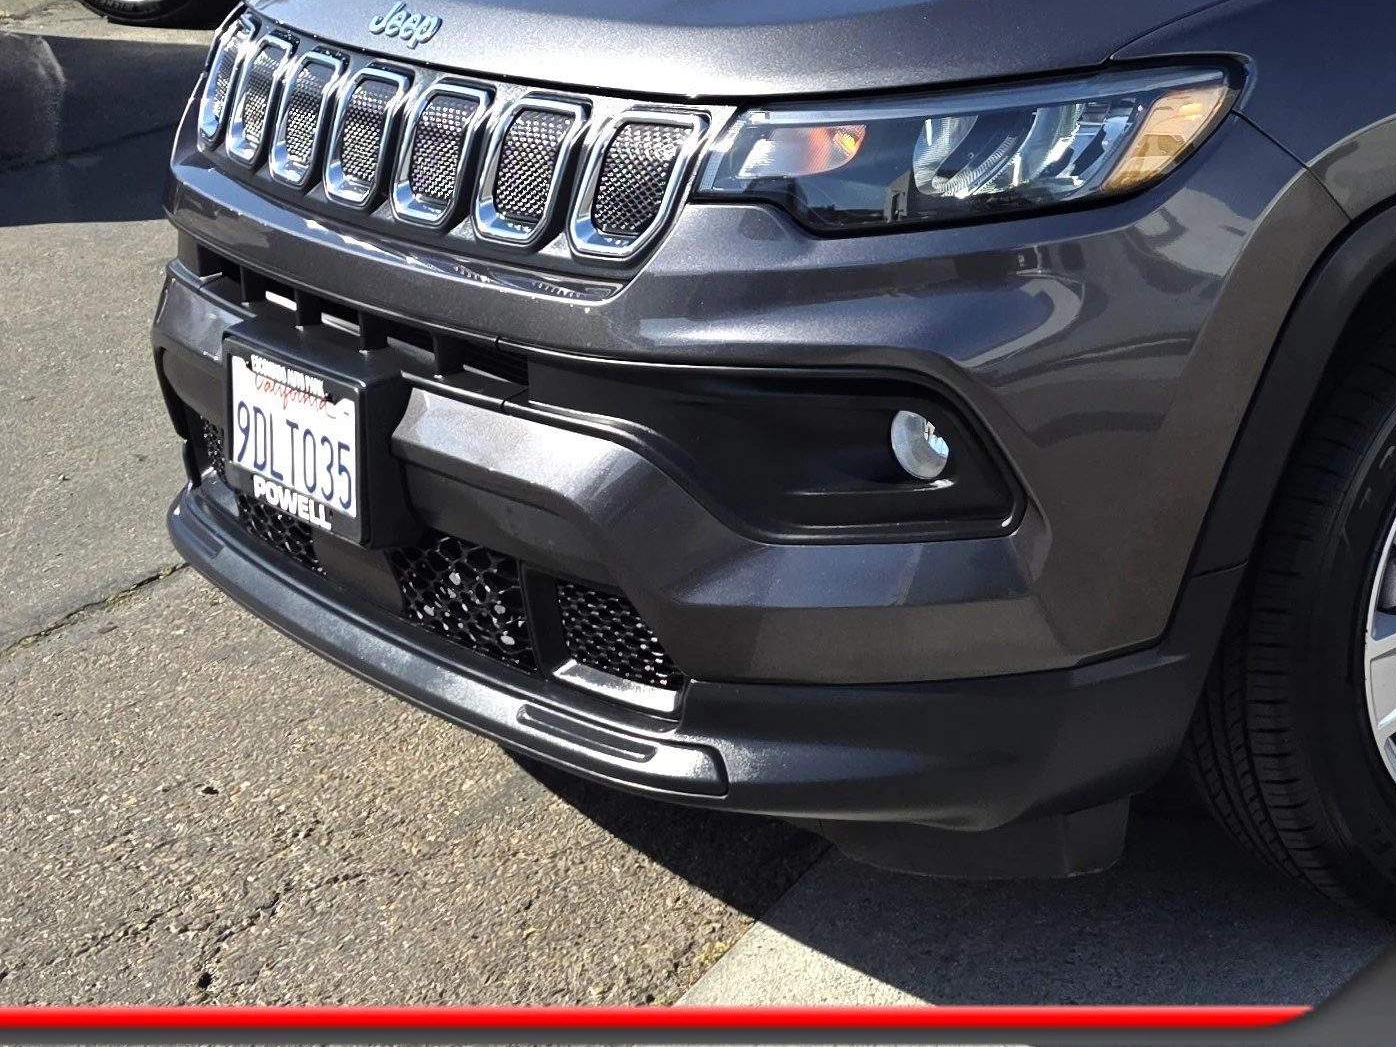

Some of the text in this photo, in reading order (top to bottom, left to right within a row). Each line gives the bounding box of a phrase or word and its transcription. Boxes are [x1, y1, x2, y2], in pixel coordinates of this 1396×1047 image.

[369, 1, 443, 50] Jeep
[237, 400, 352, 510] 9DLT035
[253, 474, 332, 530] POWELL
